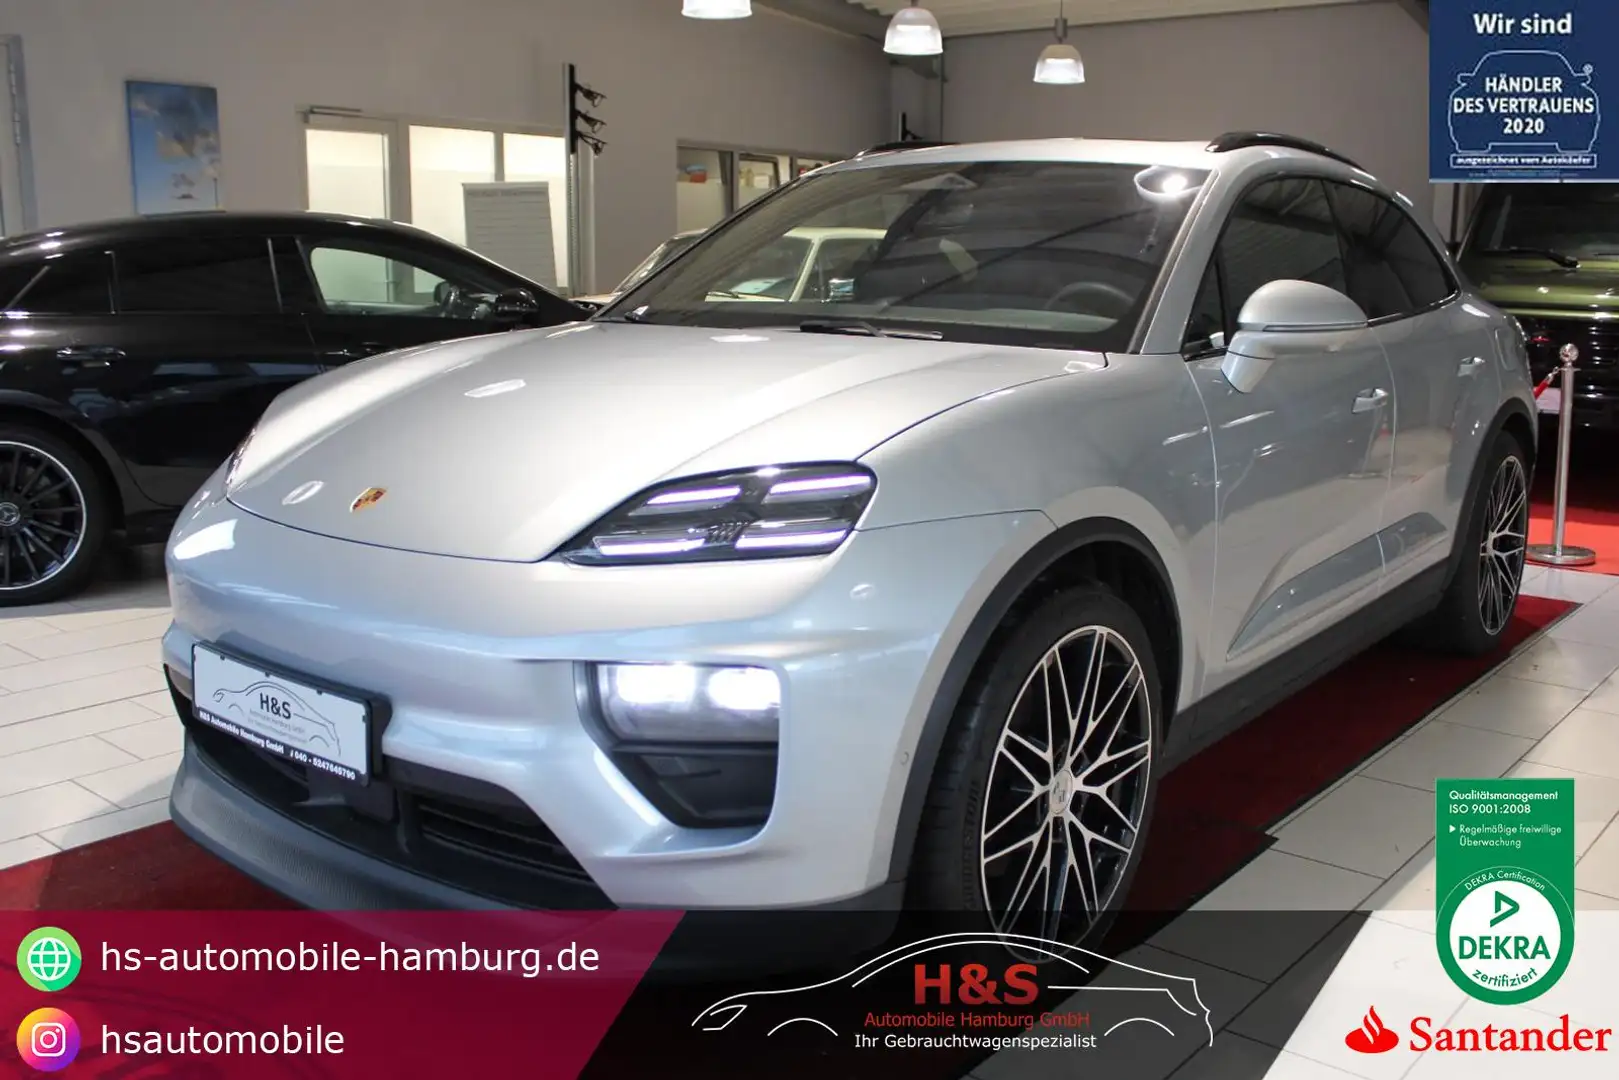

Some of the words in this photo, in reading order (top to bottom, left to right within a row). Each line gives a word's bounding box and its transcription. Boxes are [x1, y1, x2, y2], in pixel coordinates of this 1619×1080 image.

[260, 692, 291, 719] H&S
[210, 715, 240, 736] Automobile
[240, 728, 265, 748] Hamburg
[266, 739, 284, 754] GmbH
